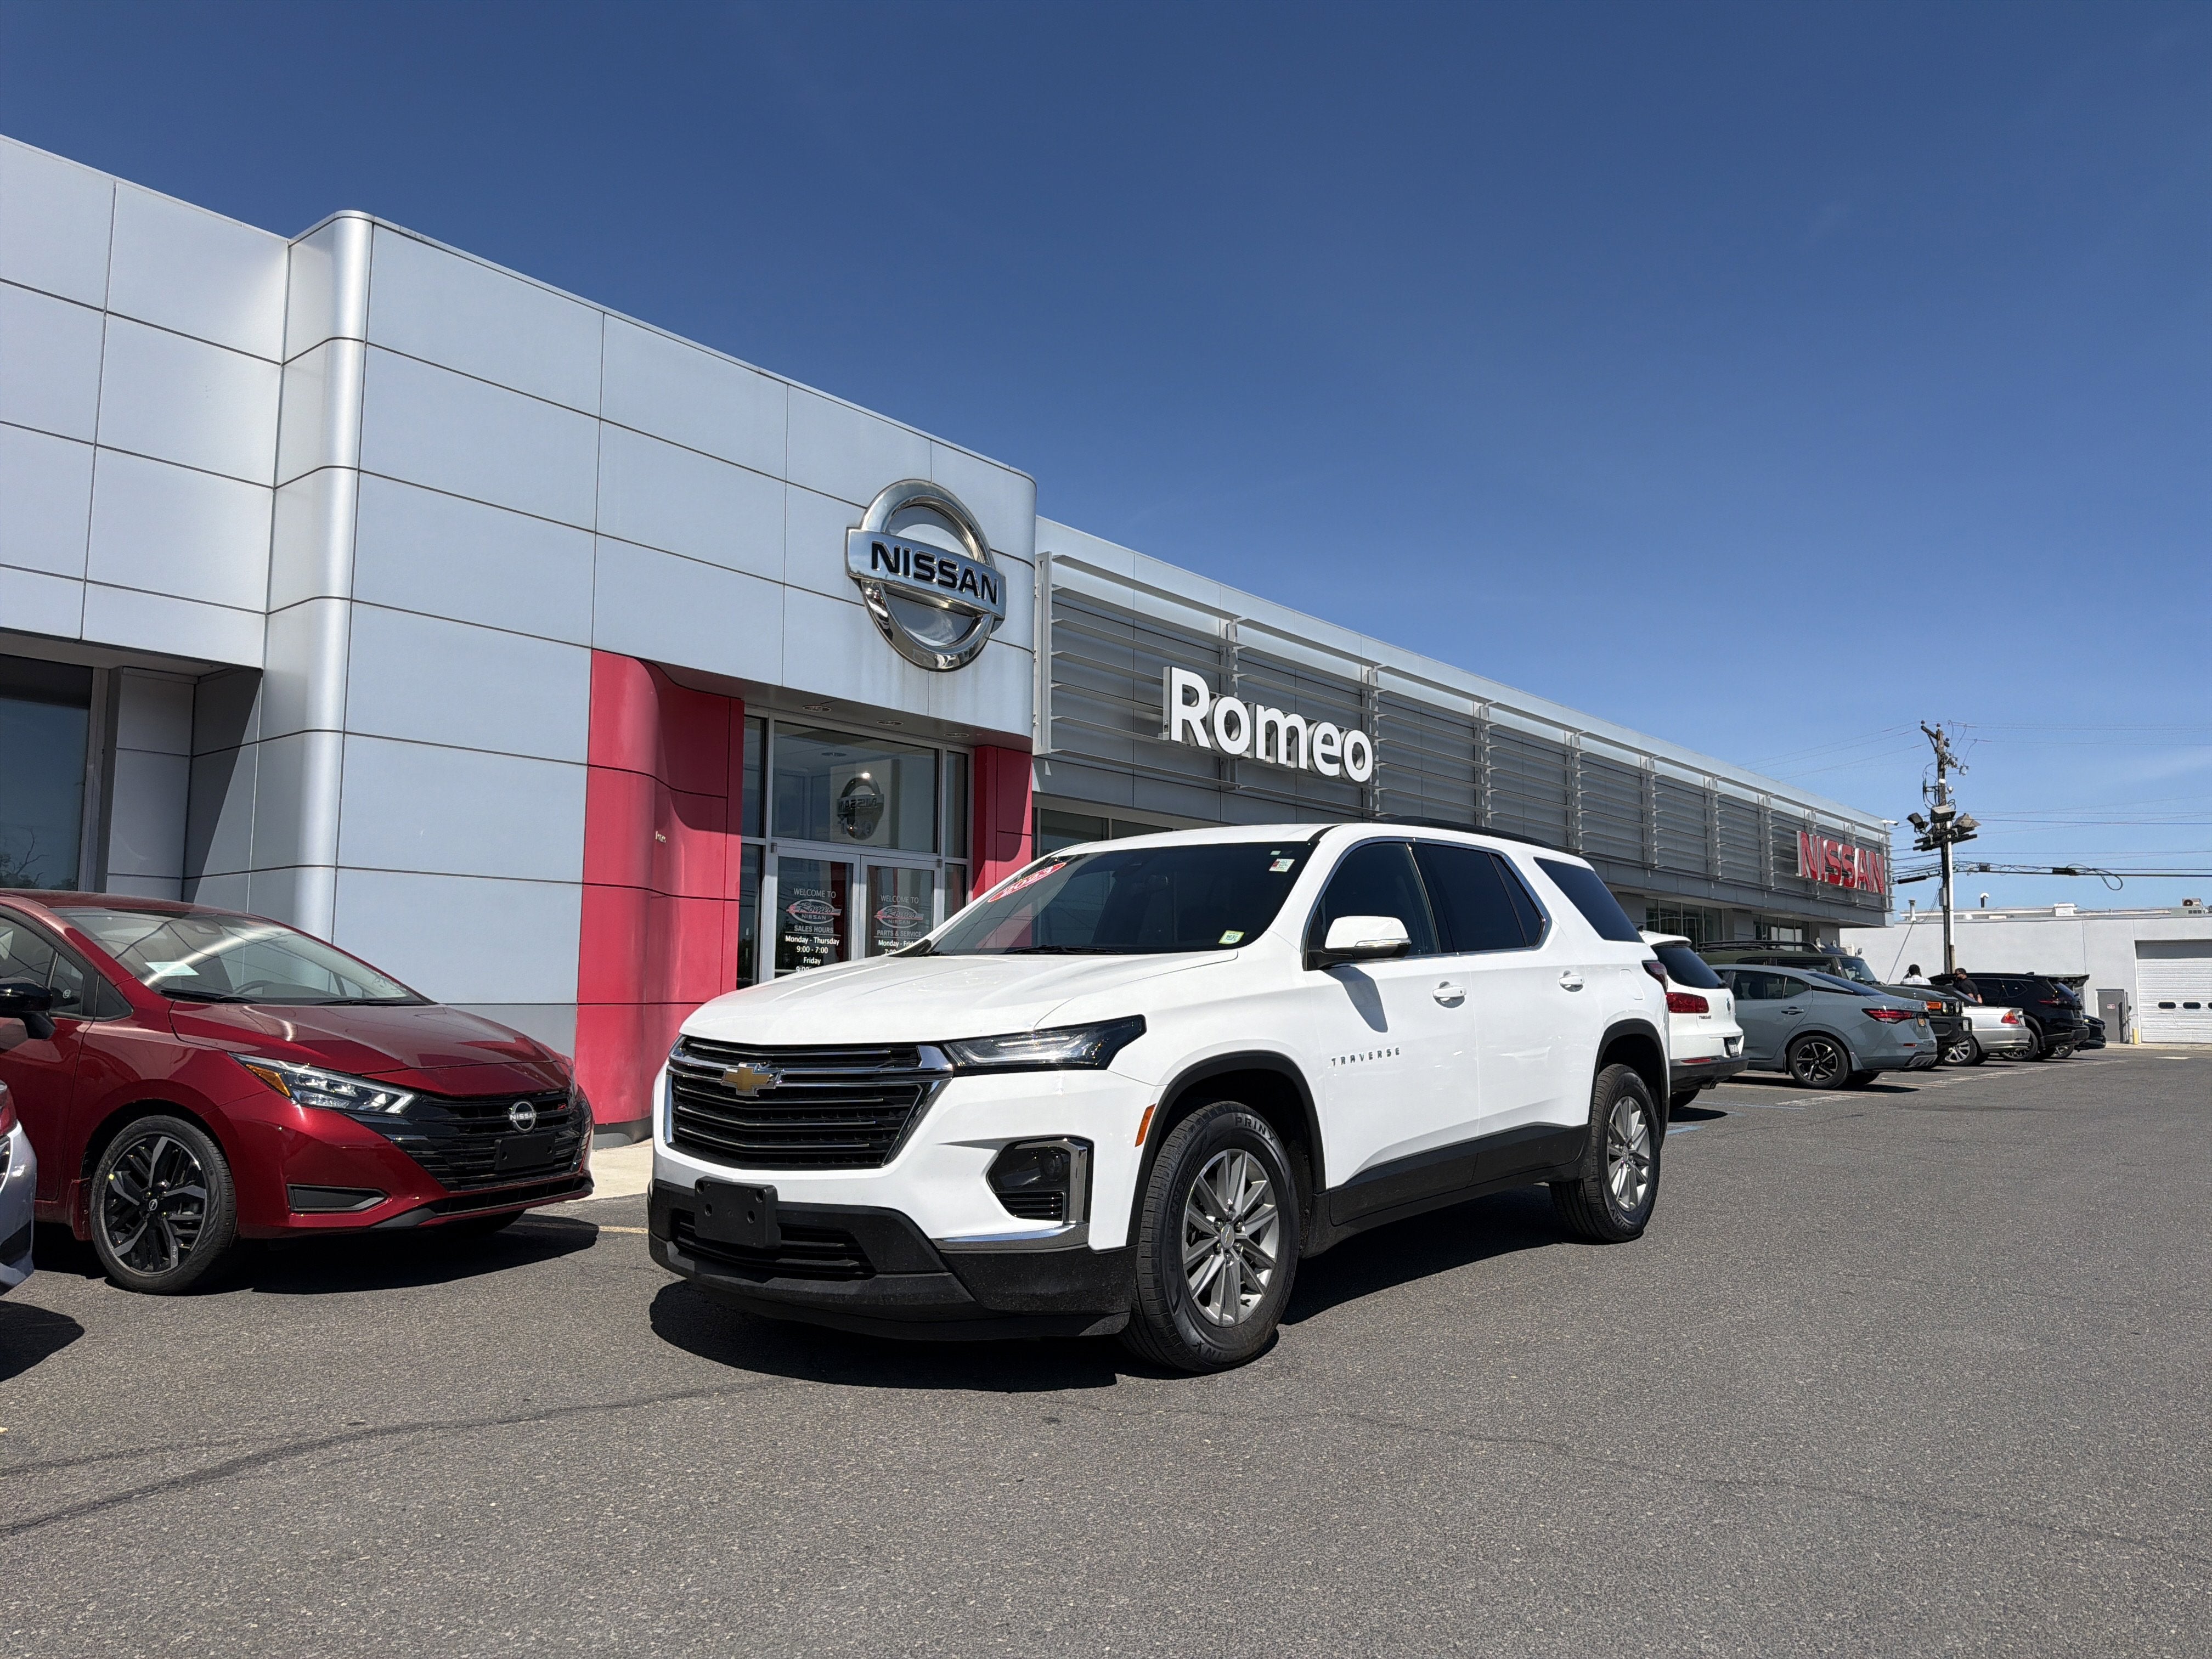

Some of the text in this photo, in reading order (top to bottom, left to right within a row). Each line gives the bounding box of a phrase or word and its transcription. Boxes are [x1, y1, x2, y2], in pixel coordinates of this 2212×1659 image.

[871, 540, 999, 605] NISSAN
[1163, 665, 1373, 783] Romeo
[1797, 831, 1885, 895] NISSAN
[794, 888, 826, 898] WELCOME
[881, 894, 910, 903] WELCOME
[799, 900, 833, 913] Romeo
[884, 907, 916, 918] Romeo
[785, 935, 809, 945] Monday
[813, 936, 840, 946] Thursday
[878, 939, 899, 948] Monday
[803, 956, 821, 966] Friday
[1331, 1047, 1400, 1066] TRAVERSE
[509, 1112, 537, 1121] NISSAN
[1235, 1116, 1276, 1143] PRINX
